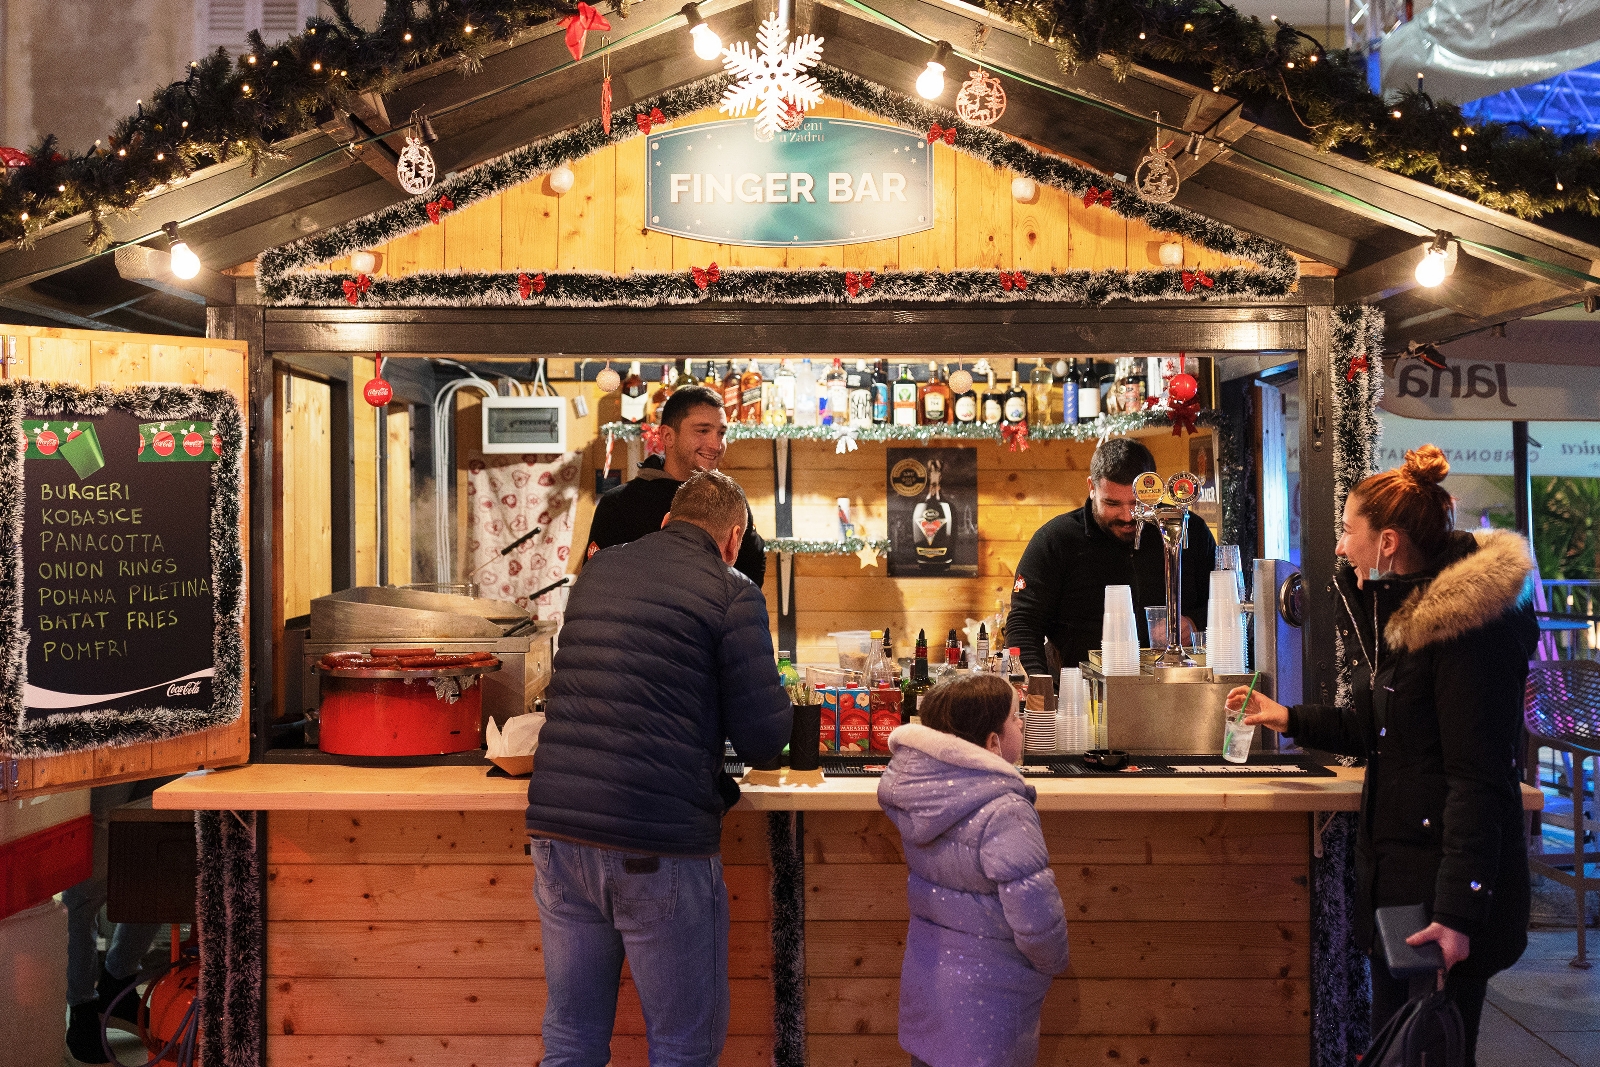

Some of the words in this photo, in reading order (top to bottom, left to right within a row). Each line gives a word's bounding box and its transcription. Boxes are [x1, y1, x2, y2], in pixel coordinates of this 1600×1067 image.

[779, 133, 787, 142] u
[789, 132, 825, 143] Zadru
[670, 172, 815, 204] FINGER
[829, 172, 908, 204] BAR
[41, 483, 130, 501] BURGERI
[42, 507, 144, 526] KOBASICE
[40, 531, 166, 553] PANACOTTA
[38, 560, 104, 580] ONION
[119, 558, 178, 577] RINGS
[39, 586, 116, 607] POHANA
[129, 577, 211, 604] PILETINA
[39, 612, 109, 631] BATAT
[127, 609, 179, 630] FRIES
[43, 640, 128, 661] POMFRI
[166, 681, 200, 697] Coca-Cola
